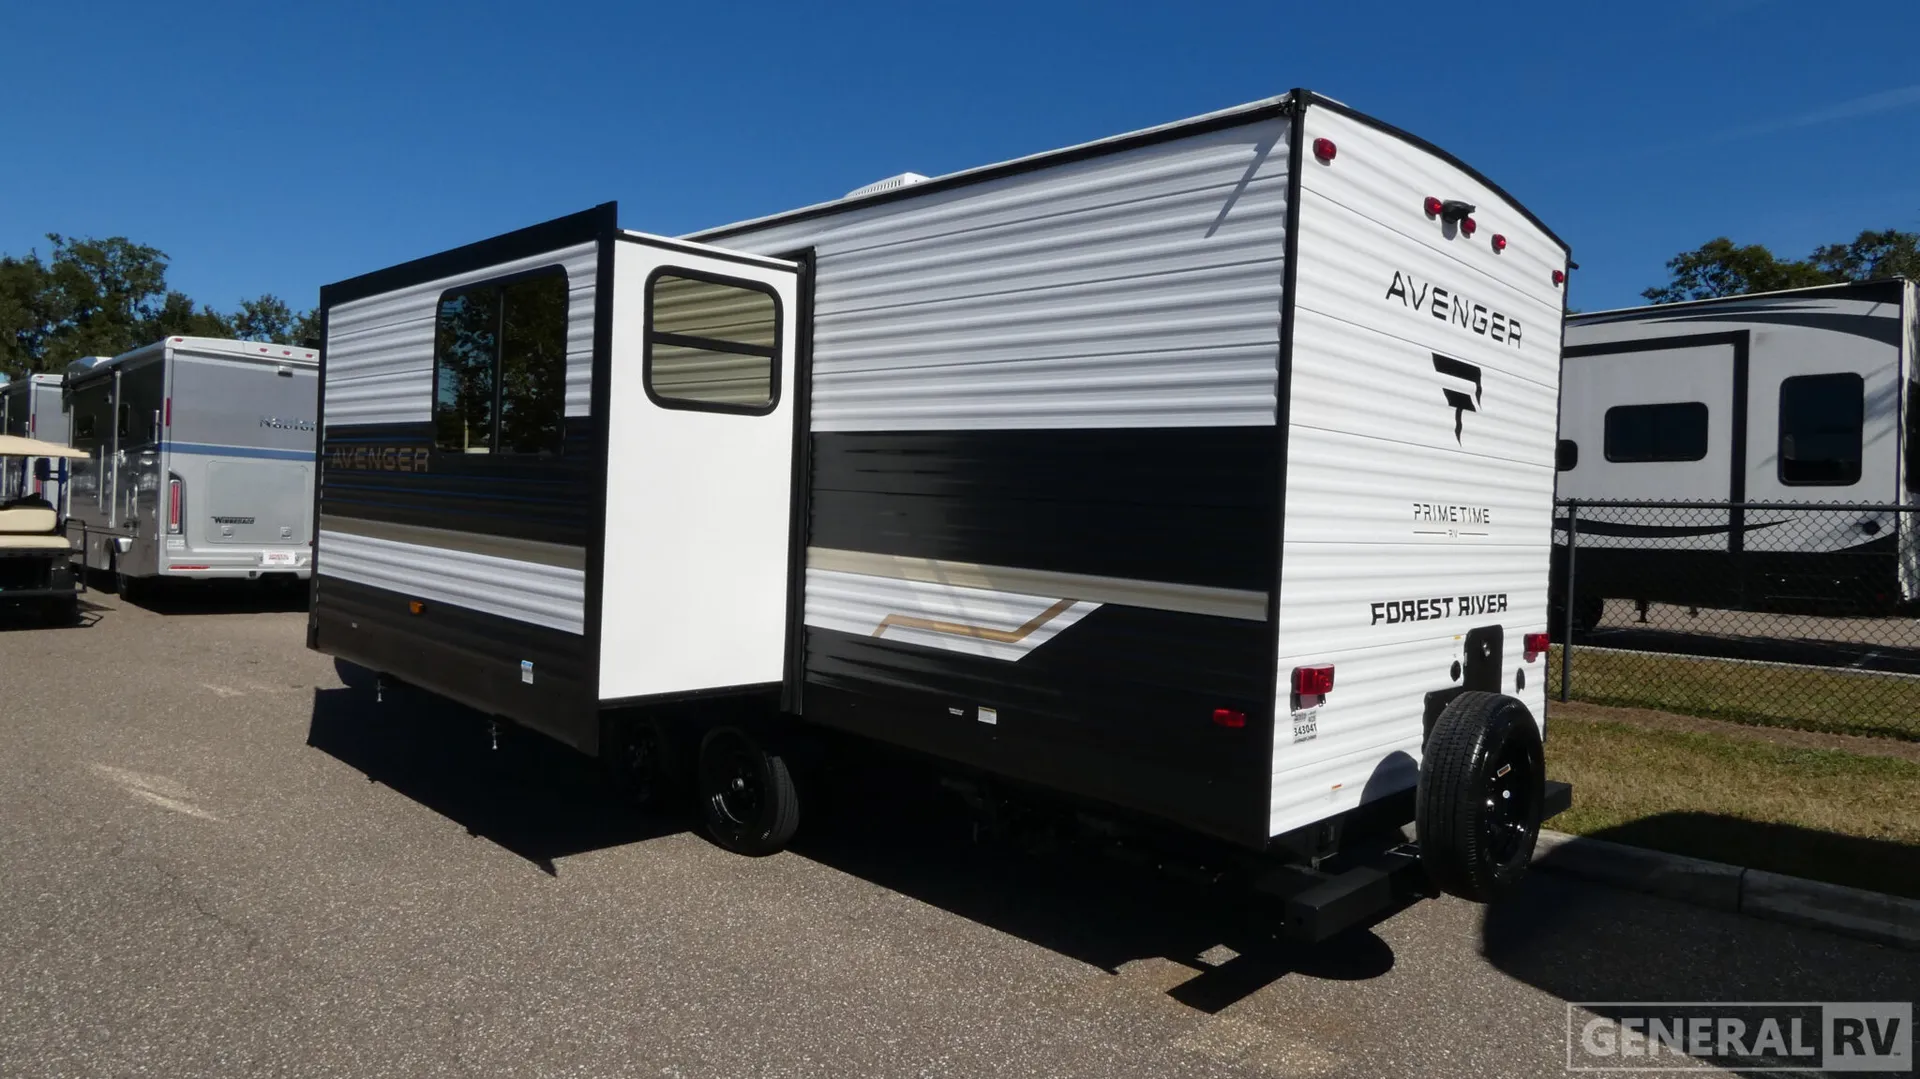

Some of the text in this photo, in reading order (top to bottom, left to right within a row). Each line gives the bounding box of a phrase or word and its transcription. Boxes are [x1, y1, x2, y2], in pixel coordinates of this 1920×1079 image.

[1386, 271, 1523, 349] AVENGER
[331, 447, 430, 472] AVENGER
[1370, 593, 1508, 626] FOREST RIVER
[1293, 723, 1318, 737] 343041
